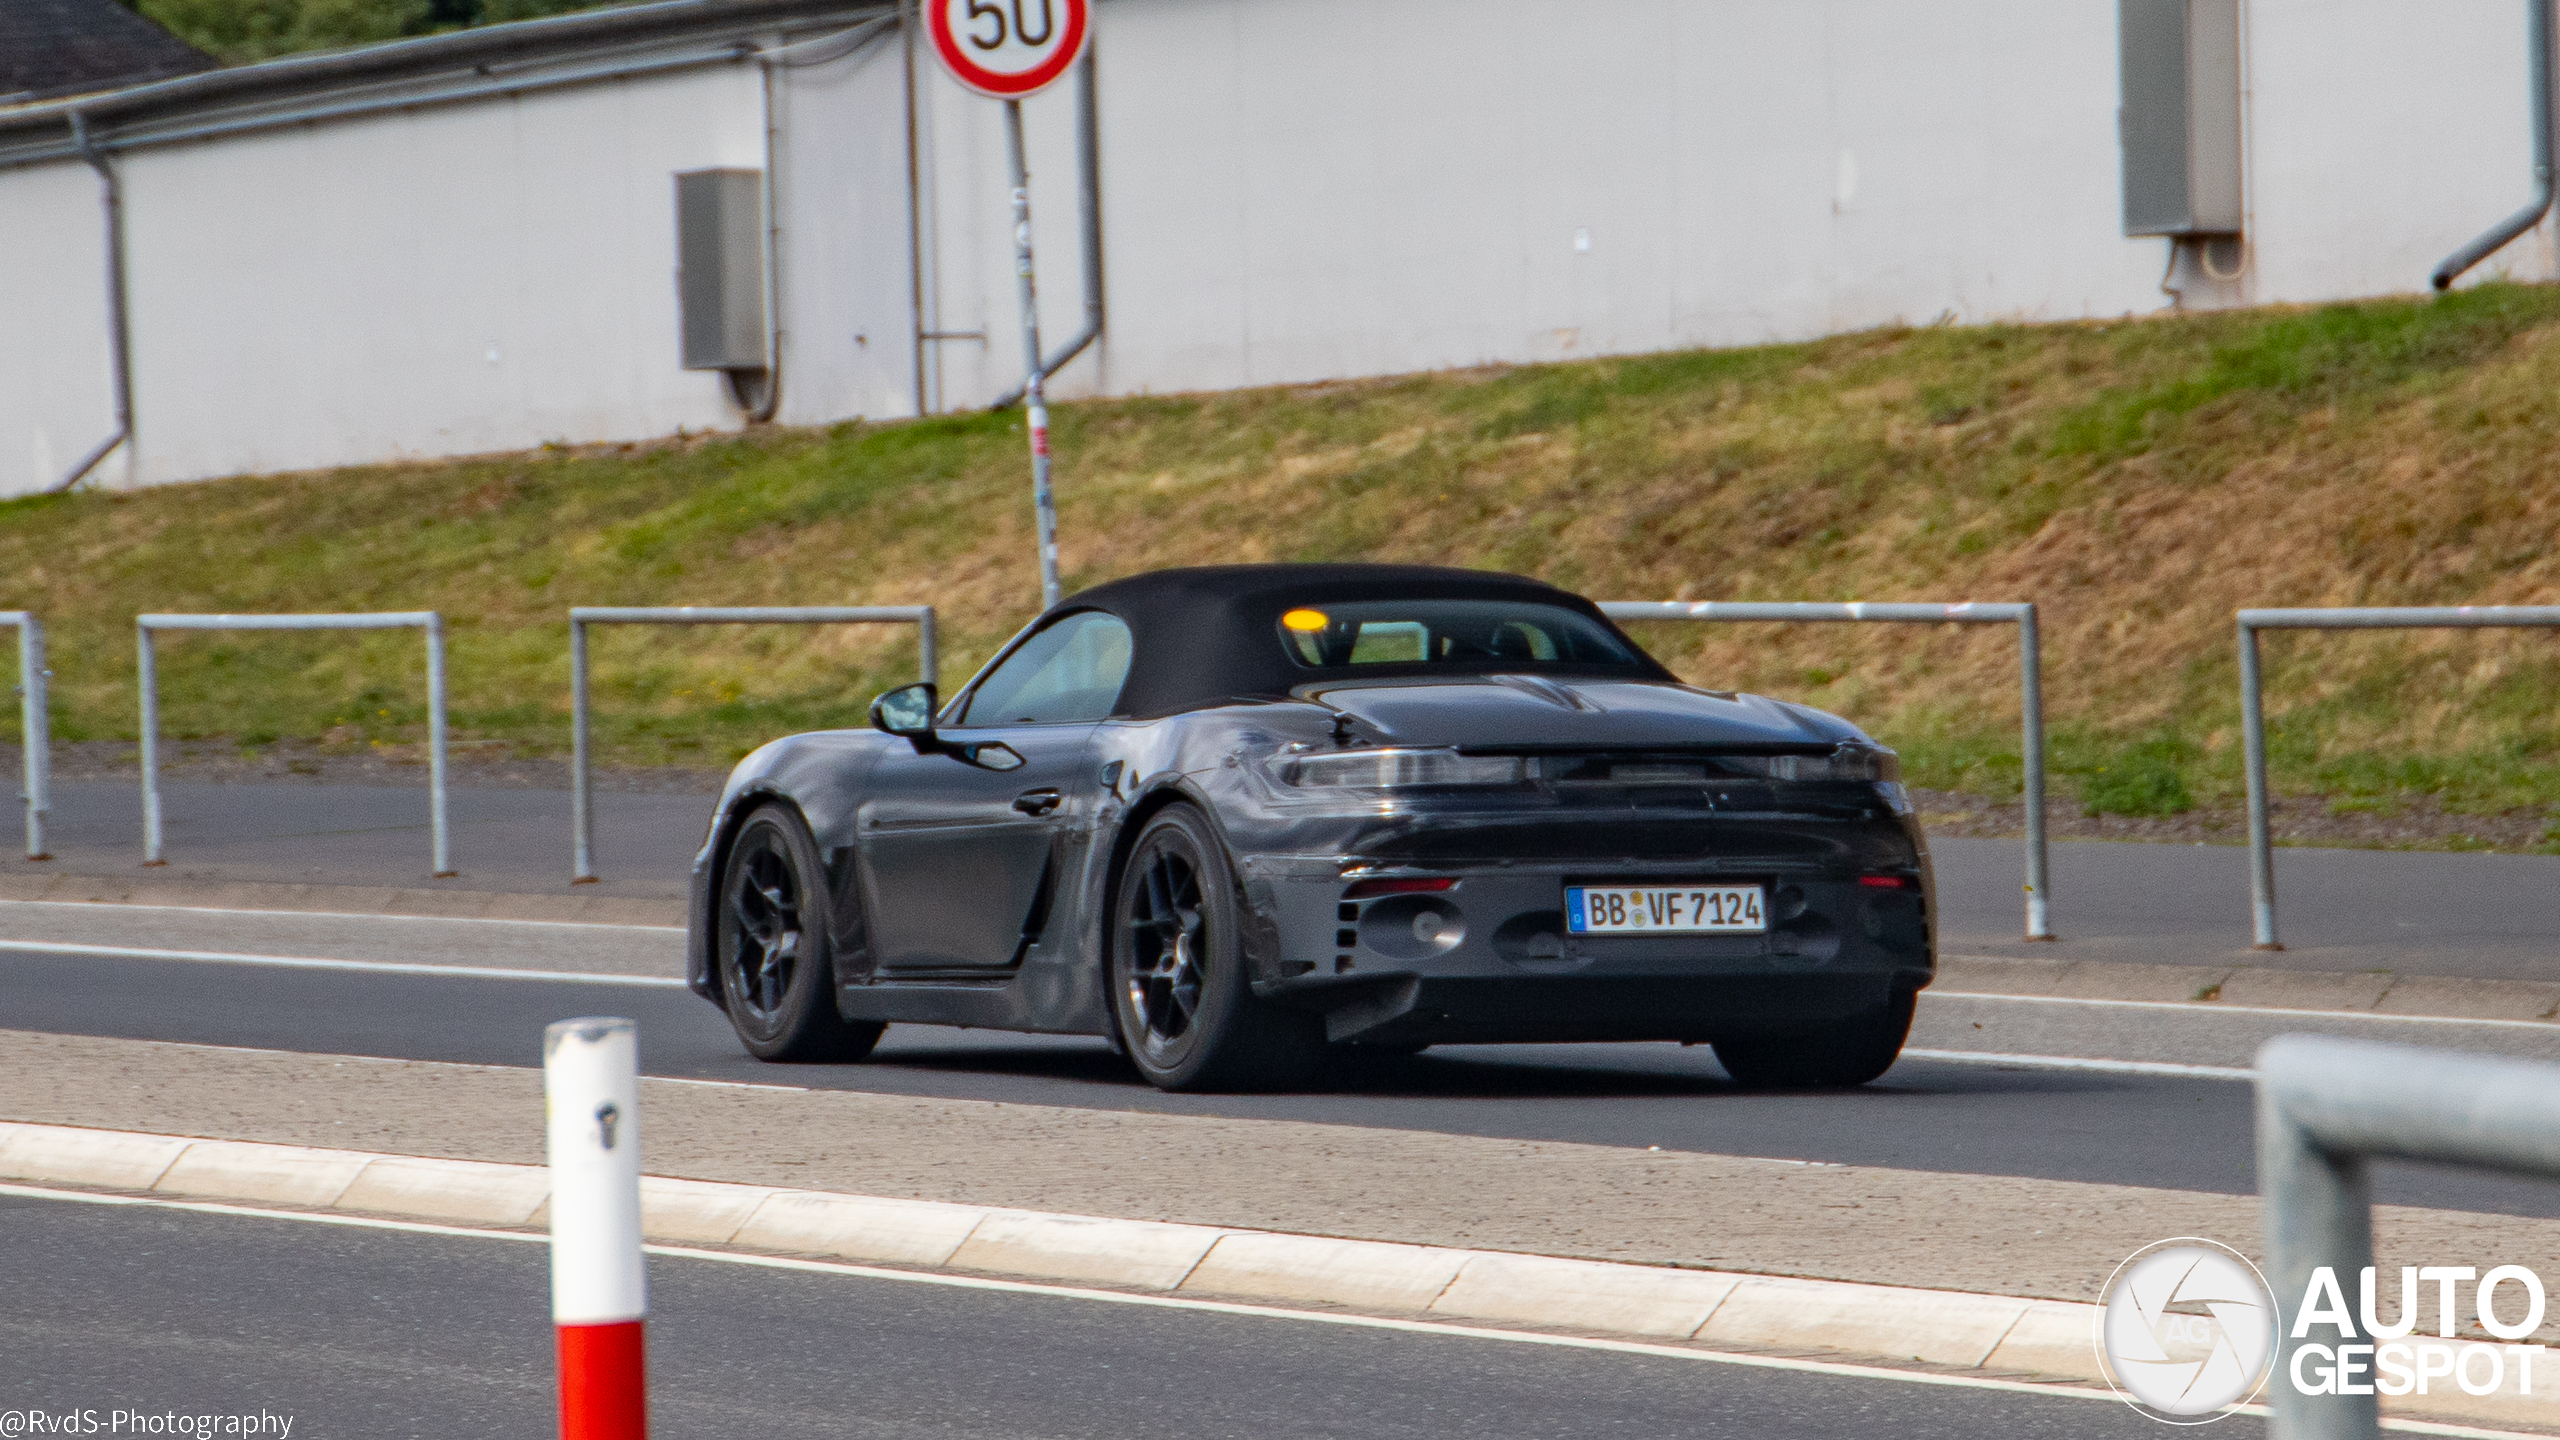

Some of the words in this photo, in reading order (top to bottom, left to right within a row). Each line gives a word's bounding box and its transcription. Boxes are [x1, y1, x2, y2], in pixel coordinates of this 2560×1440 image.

[968, 0, 1053, 50] 50
[1589, 893, 1627, 926] BB
[1648, 892, 1683, 925] VF
[1690, 892, 1760, 925] 7124
